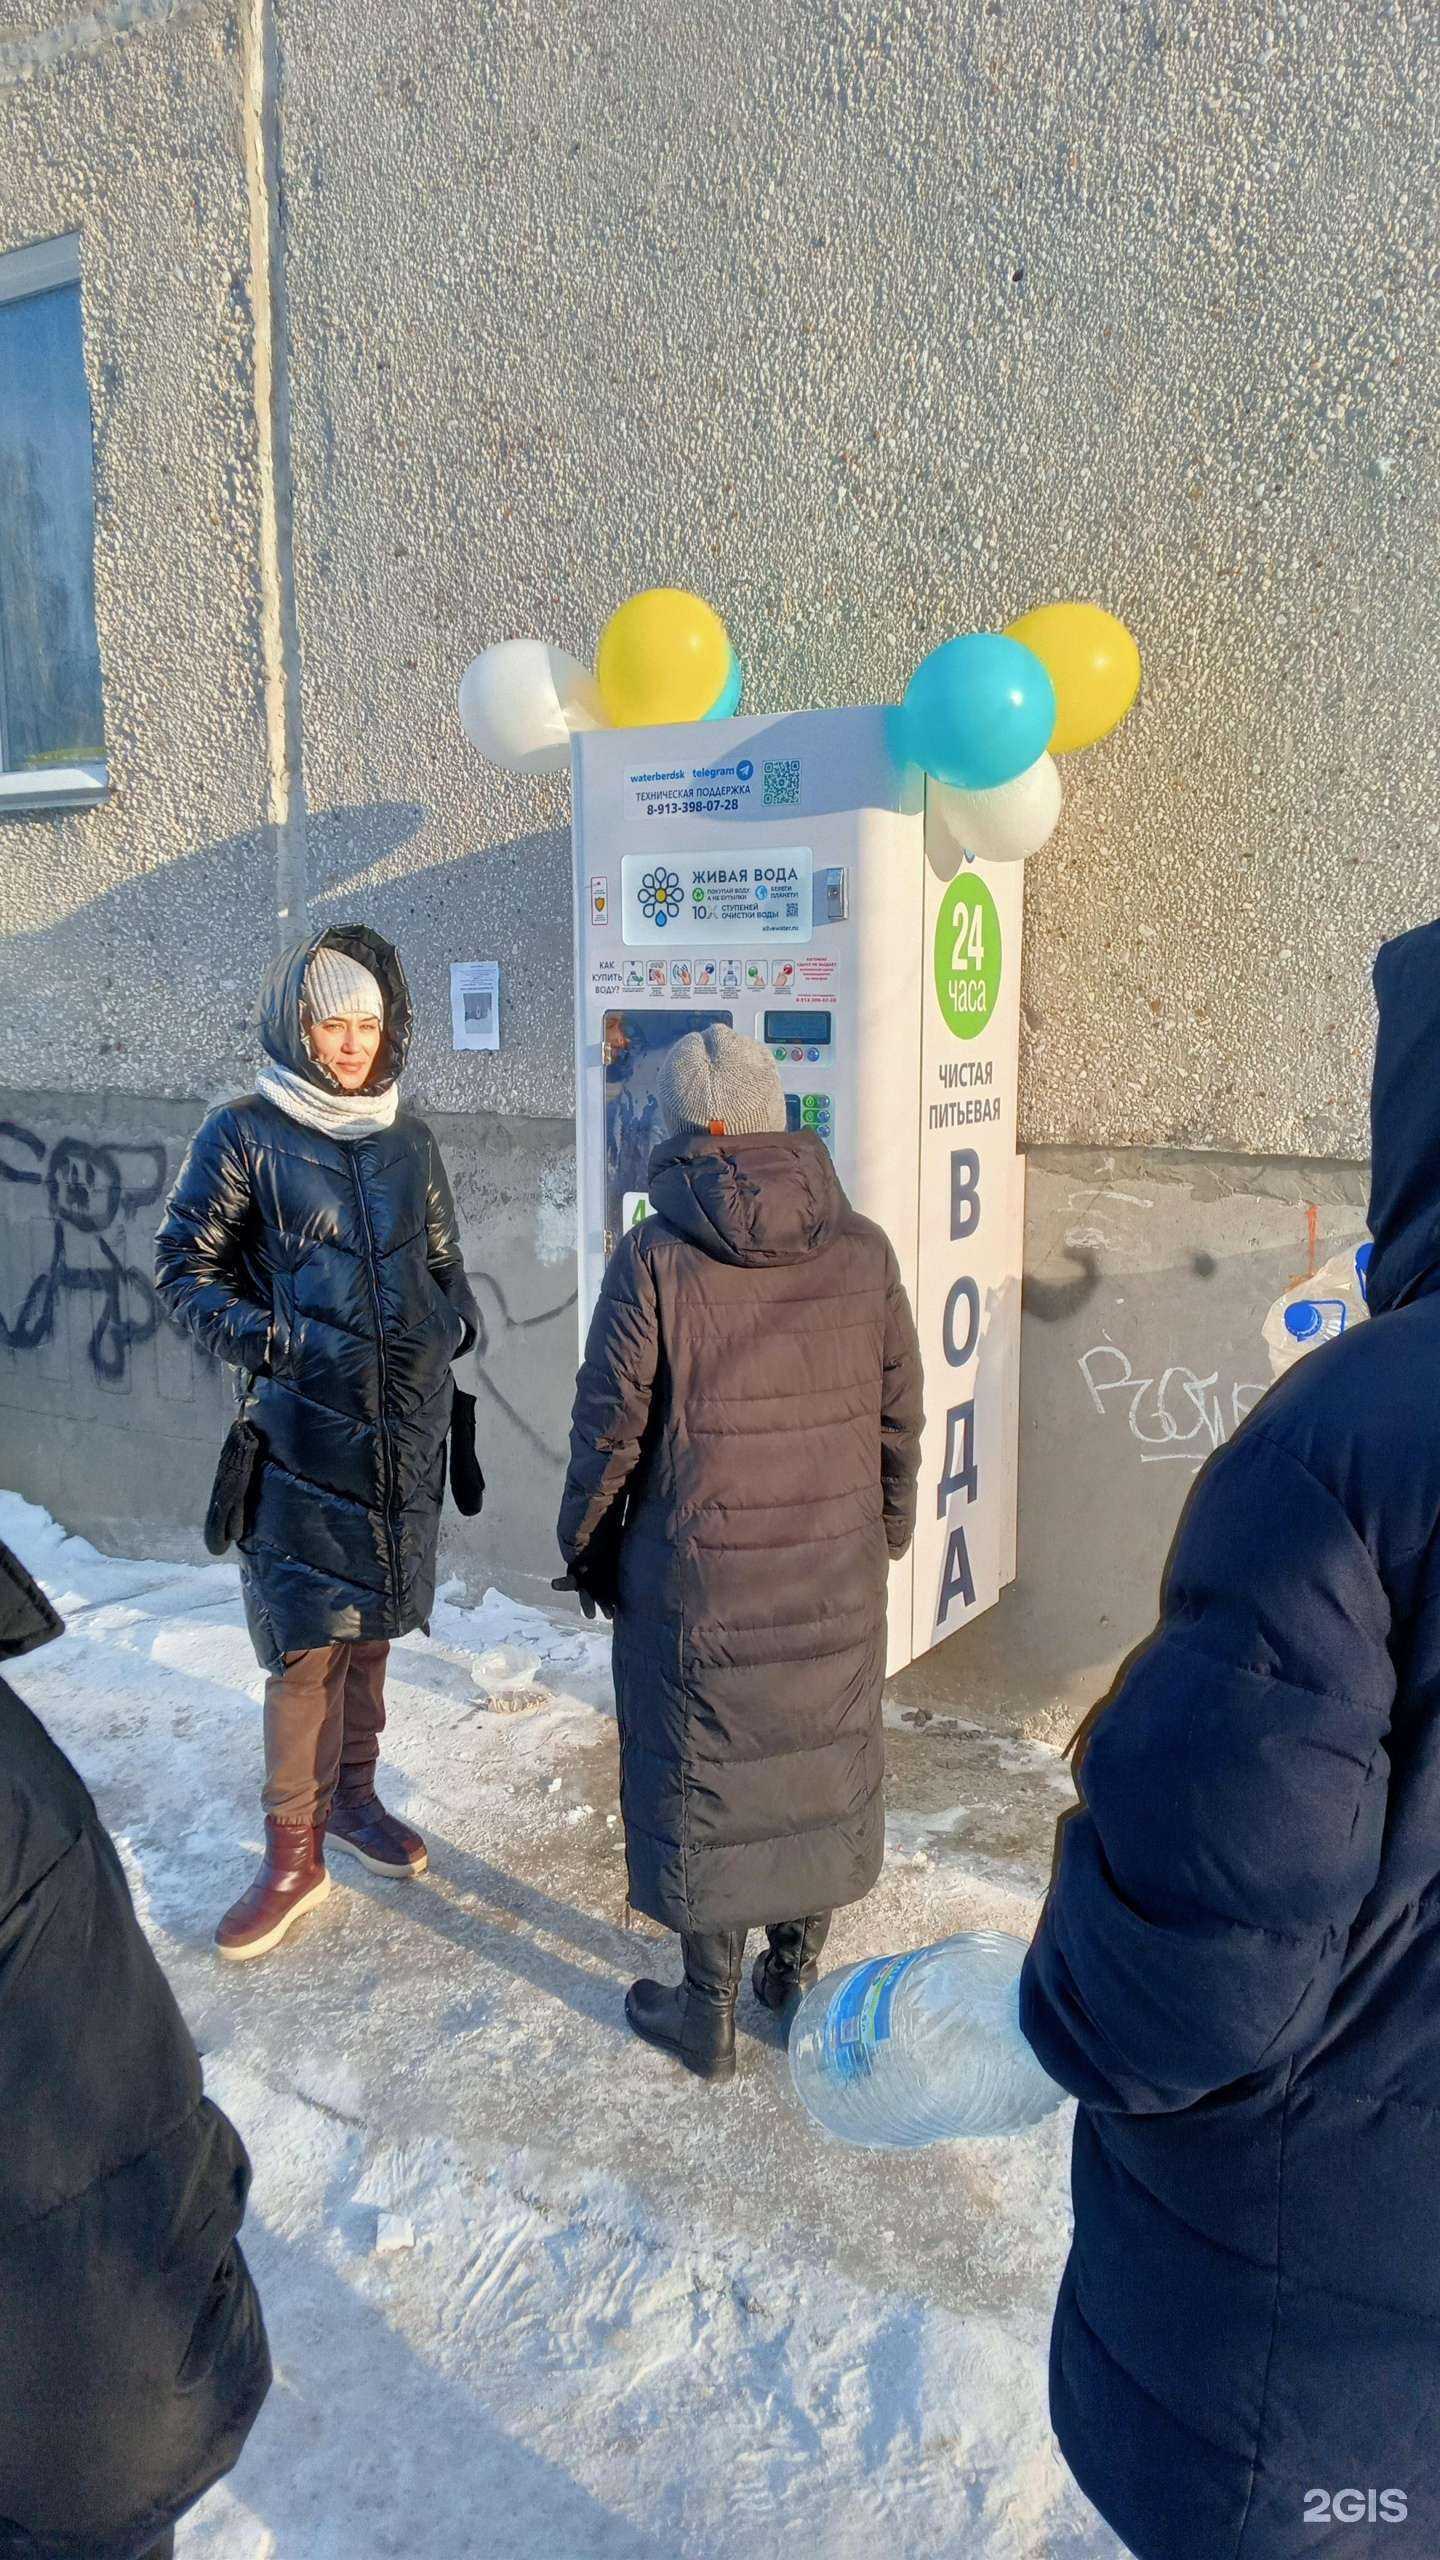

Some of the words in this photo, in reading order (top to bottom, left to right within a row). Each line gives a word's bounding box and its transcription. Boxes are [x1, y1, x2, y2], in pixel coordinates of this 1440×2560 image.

[630, 770, 685, 783] waterberdsk
[692, 767, 735, 779] telegram
[635, 788, 694, 801] ТЕХНИЧЕСКАЯ
[696, 785, 751, 798] ПОДДЕРЖКА
[647, 799, 739, 815] 8-913-398-07-28
[692, 869, 748, 883] ЖИВАЯ
[754, 868, 798, 882] ВОДА
[721, 903, 759, 911] СТУПЕНЕЙ
[721, 912, 755, 920] ОЧИСТКИ
[951, 901, 984, 971] 24
[599, 961, 615, 969] КАК
[592, 973, 623, 982] КУПИТЬ
[595, 986, 620, 994] ВОДУ?
[948, 979, 987, 1013] часа
[938, 1061, 993, 1089] ЧИСТАЯ
[928, 1097, 1001, 1130] ПИТЬЕВАЯ
[936, 1147, 981, 1627] ВОДА
